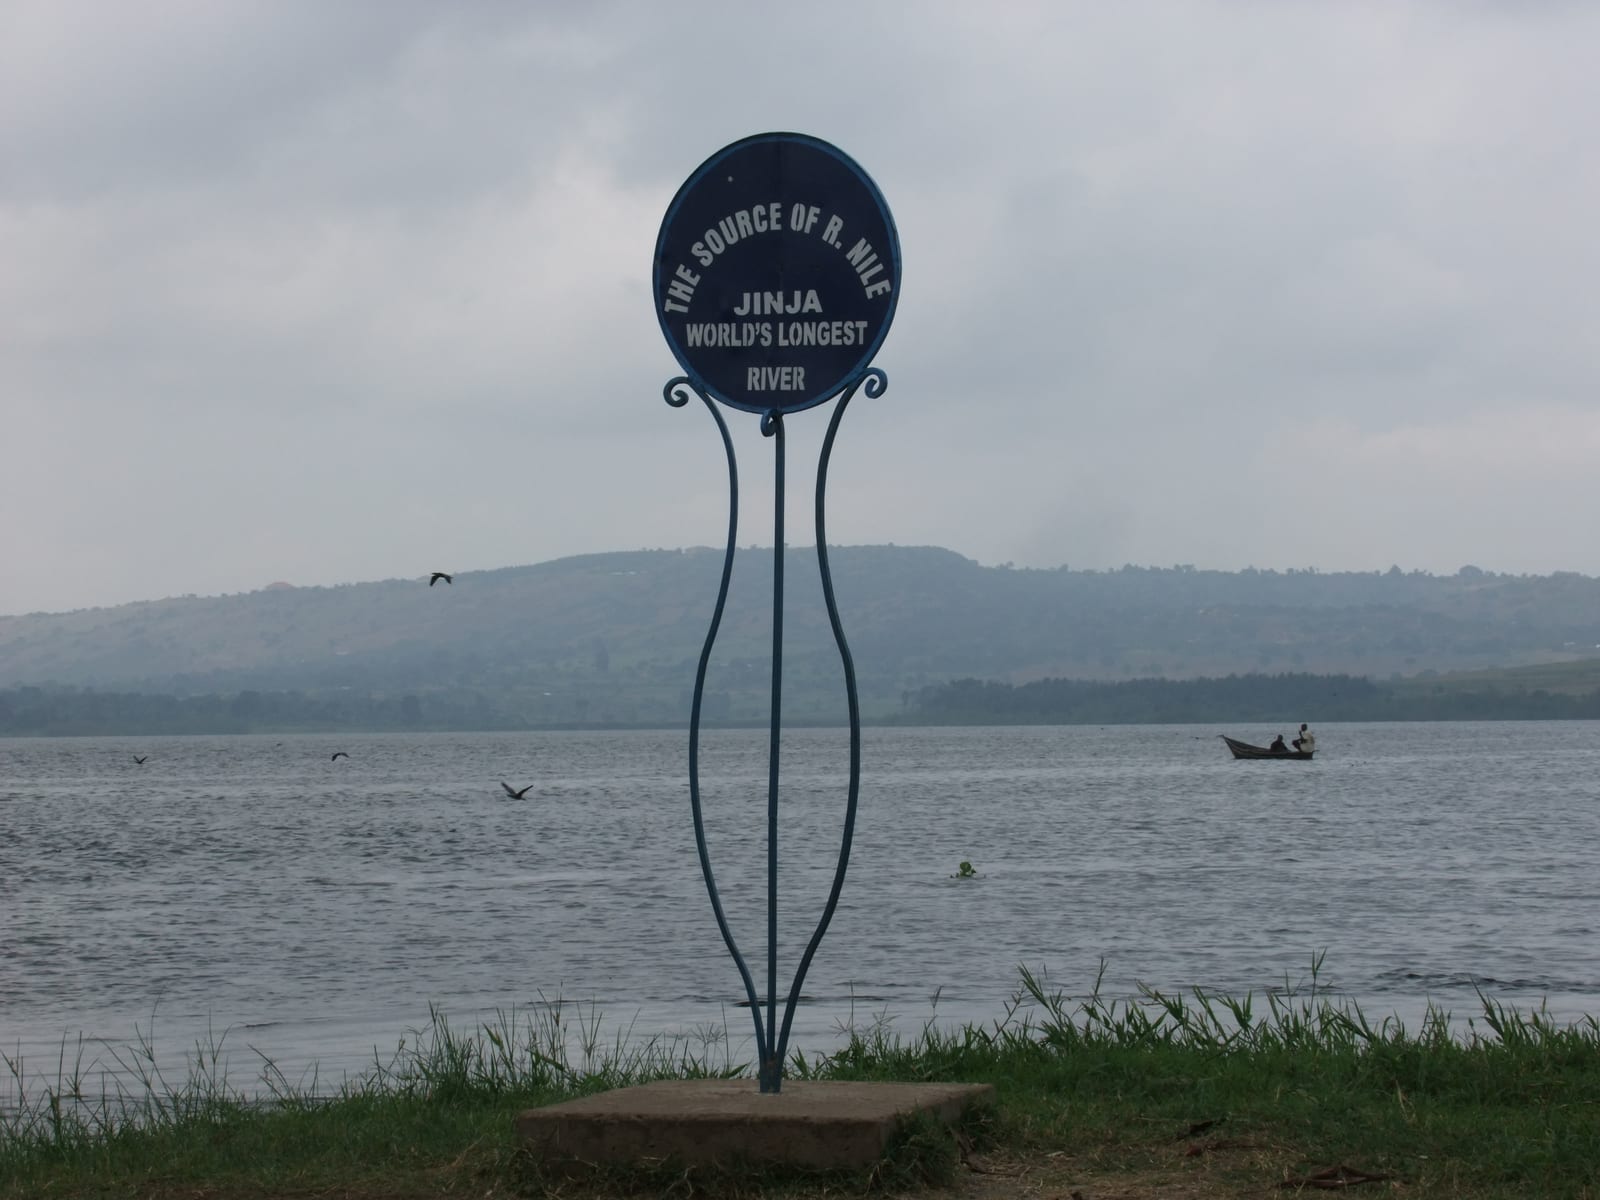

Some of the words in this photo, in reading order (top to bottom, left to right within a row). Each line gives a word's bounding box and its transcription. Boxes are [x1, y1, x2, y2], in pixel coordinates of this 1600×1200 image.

[664, 263, 701, 313] THE
[690, 202, 784, 267] SOURCE
[790, 203, 820, 234] OF
[822, 214, 844, 250] R.
[846, 237, 892, 299] NILE
[733, 289, 823, 315] JINJA
[686, 322, 773, 349] WORLD'S
[777, 320, 869, 347] LONGEST
[747, 366, 806, 392] RIVER
